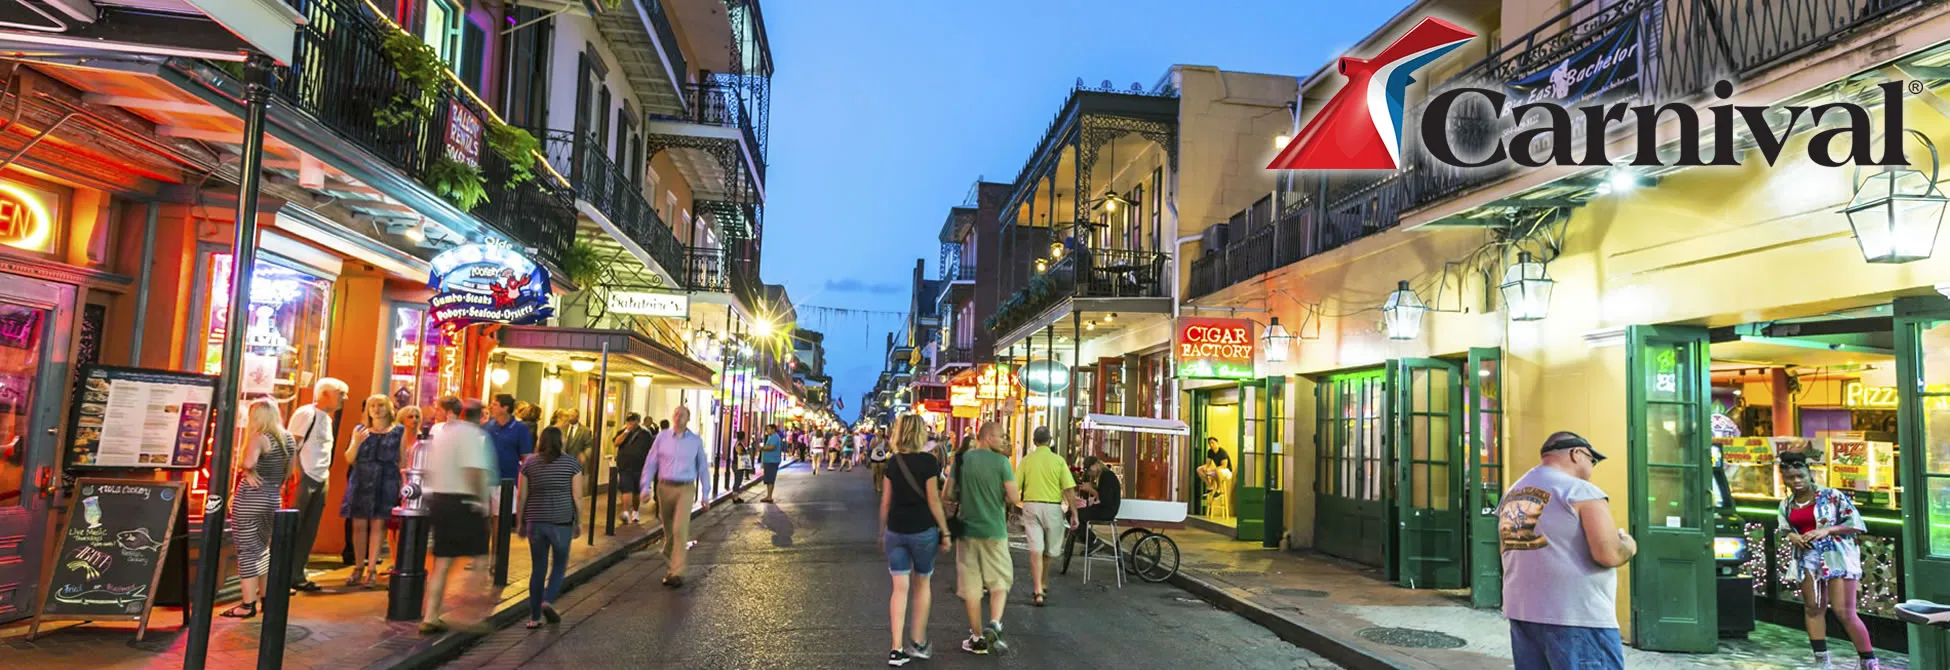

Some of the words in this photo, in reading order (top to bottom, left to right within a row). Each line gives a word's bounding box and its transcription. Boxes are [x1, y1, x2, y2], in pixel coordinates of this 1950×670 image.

[1527, 84, 1557, 105] Easy
[1566, 43, 1638, 85] Bachelor
[485, 236, 513, 250] Olde
[432, 292, 463, 307] Gumbo
[465, 292, 492, 304] Steaks
[436, 308, 466, 321] Poboys
[469, 306, 502, 320] Seafood
[503, 304, 534, 321] Oysters
[1187, 325, 1249, 344] CIGAR
[1181, 343, 1253, 359] FACTORY
